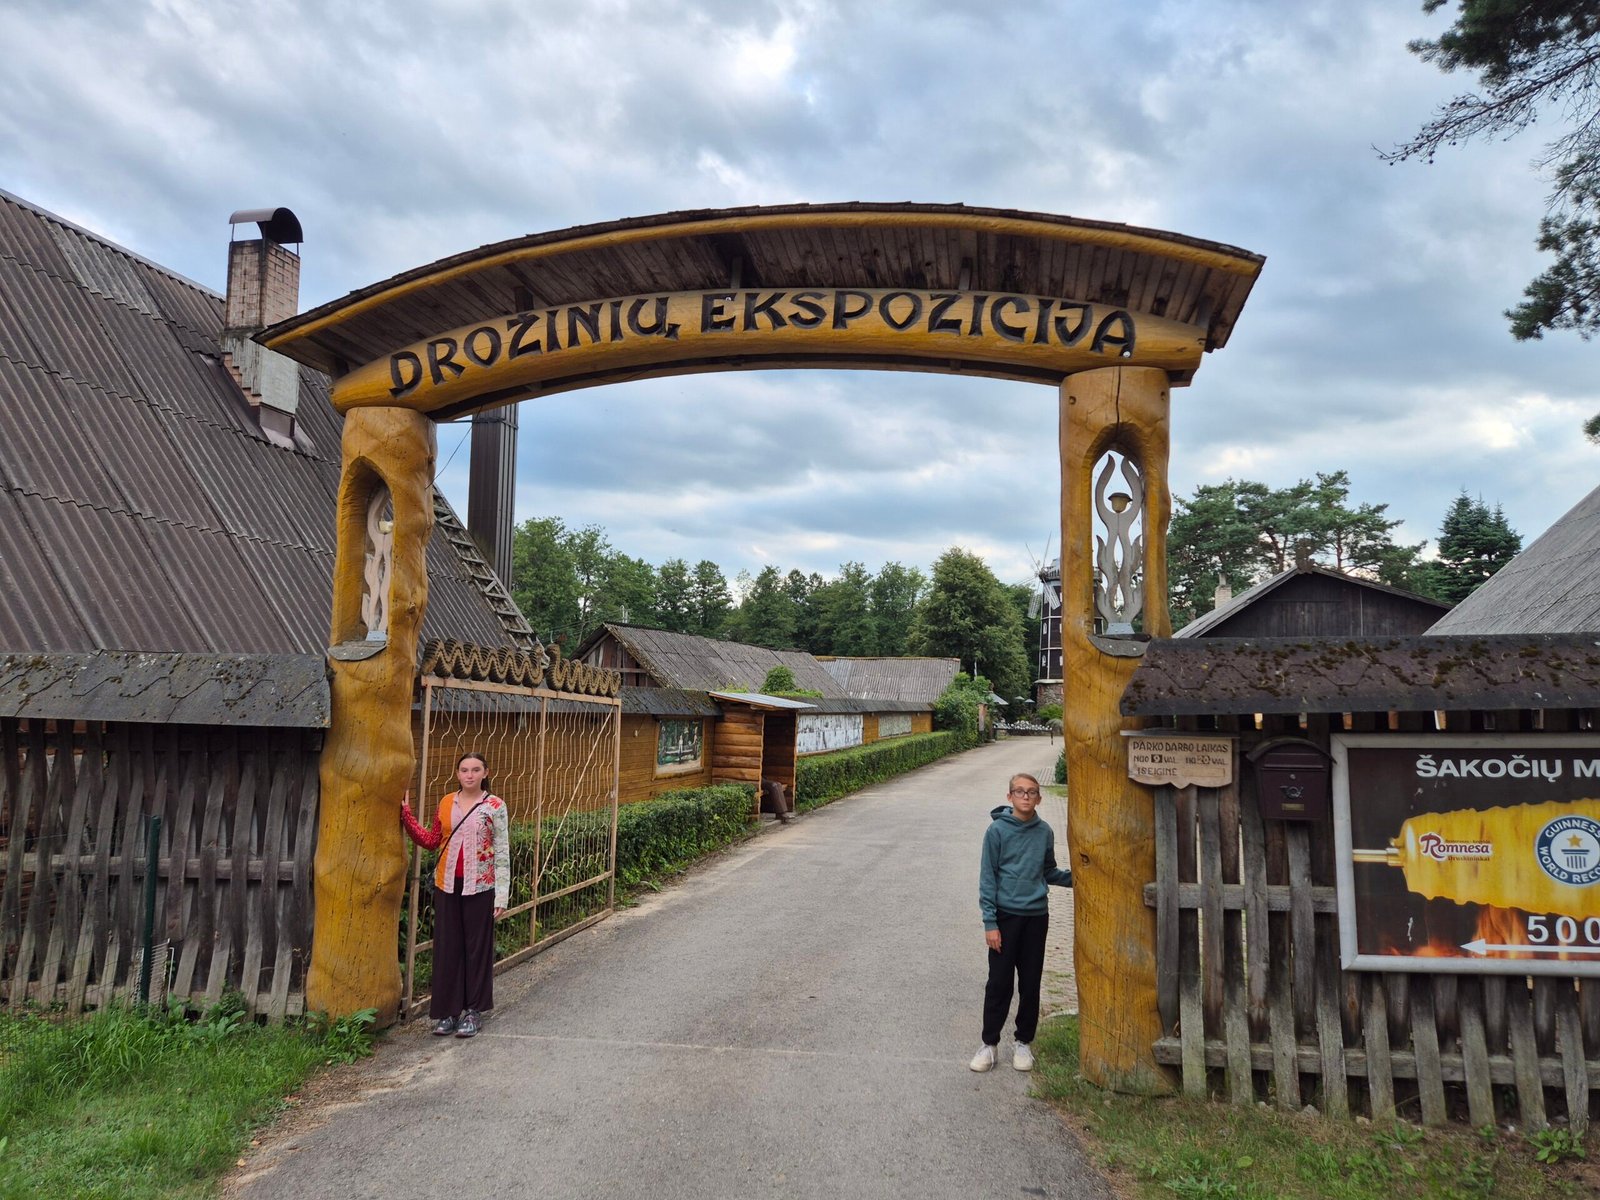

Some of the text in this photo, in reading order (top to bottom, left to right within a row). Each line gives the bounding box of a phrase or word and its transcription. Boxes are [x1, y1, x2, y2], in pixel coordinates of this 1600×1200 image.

[388, 290, 1137, 398] DROŽINIŲ EKSPOZICIJA
[1133, 741, 1229, 753] PARKO DARBO LAIKAS
[1152, 754, 1161, 763] 9
[1416, 754, 1562, 783] ŠAKOČIŲ
[1420, 832, 1490, 859] Romnesa
[1539, 846, 1568, 880] WORLD
